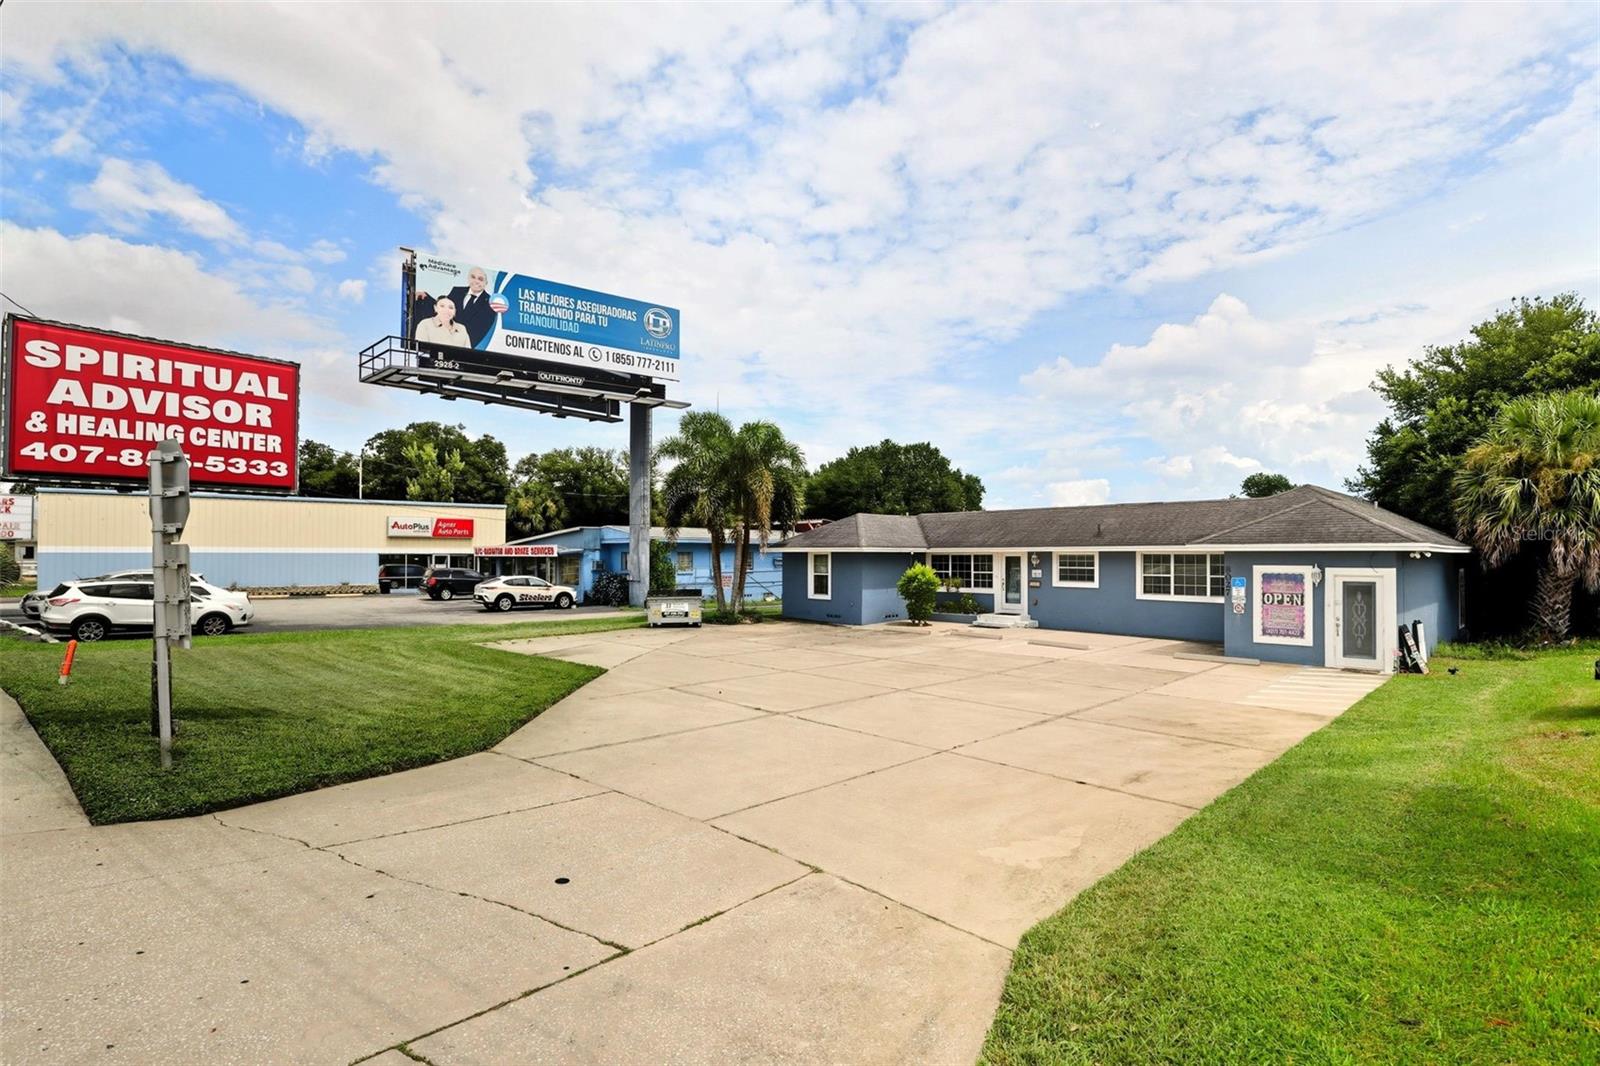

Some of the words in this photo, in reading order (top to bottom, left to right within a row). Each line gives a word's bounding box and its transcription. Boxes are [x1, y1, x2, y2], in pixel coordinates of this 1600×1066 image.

[428, 258, 456, 268] Medicare
[428, 264, 461, 277] Advantage
[518, 288, 536, 300] LAS
[537, 291, 575, 309] MEJORES
[576, 298, 637, 322] ASEGURADORAS
[518, 300, 574, 320] TRABAJANDO
[575, 311, 597, 325] PARA
[598, 316, 608, 327] TU
[519, 312, 579, 334] TRANQUILIDAD
[505, 335, 572, 356] CONTACTENOS
[573, 346, 585, 358] AL
[605, 351, 610, 362] 1
[612, 352, 635, 367] (855)
[636, 357, 675, 373] 777-2111
[24, 339, 289, 401] SPIRITUAL
[46, 378, 273, 428] ADVISOR
[25, 411, 48, 433] &
[56, 413, 185, 444] HEALING
[189, 427, 282, 453] CENTER
[20, 442, 289, 477] 407-8-5333
[391, 521, 430, 530] AutoPlus
[531, 546, 554, 555] SERVICES
[519, 593, 552, 601] Steelers
[1263, 593, 1302, 606] OPEN
